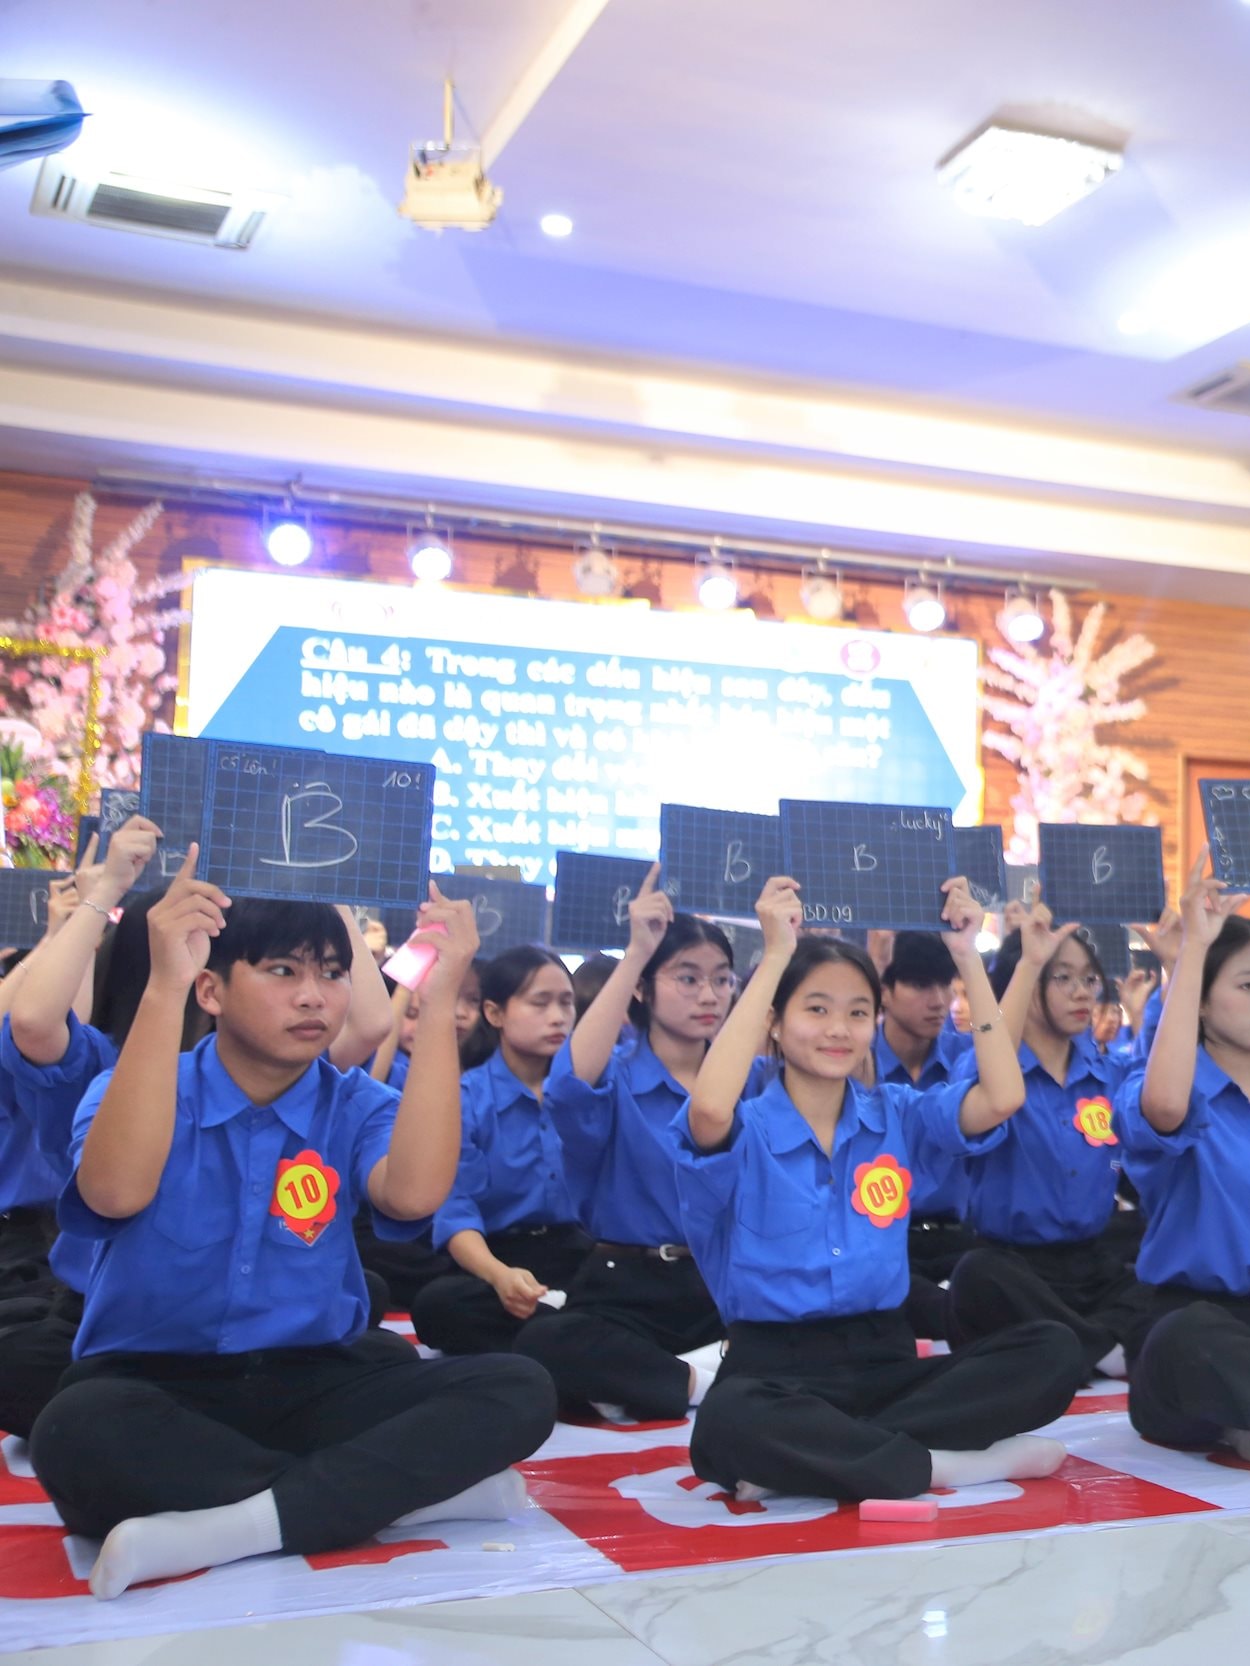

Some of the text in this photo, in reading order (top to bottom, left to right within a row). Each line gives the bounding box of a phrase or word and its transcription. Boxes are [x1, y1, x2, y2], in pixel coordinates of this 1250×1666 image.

[425, 646, 516, 685] Trong
[481, 690, 555, 716] quan
[431, 748, 462, 775] A.
[468, 749, 546, 784] Thay
[259, 783, 358, 868] B
[724, 840, 750, 883] B
[852, 843, 878, 872] B
[1092, 845, 1112, 885] B
[1086, 1111, 1110, 1131] 18
[284, 1173, 321, 1209] 10
[867, 1175, 897, 1208] 09
